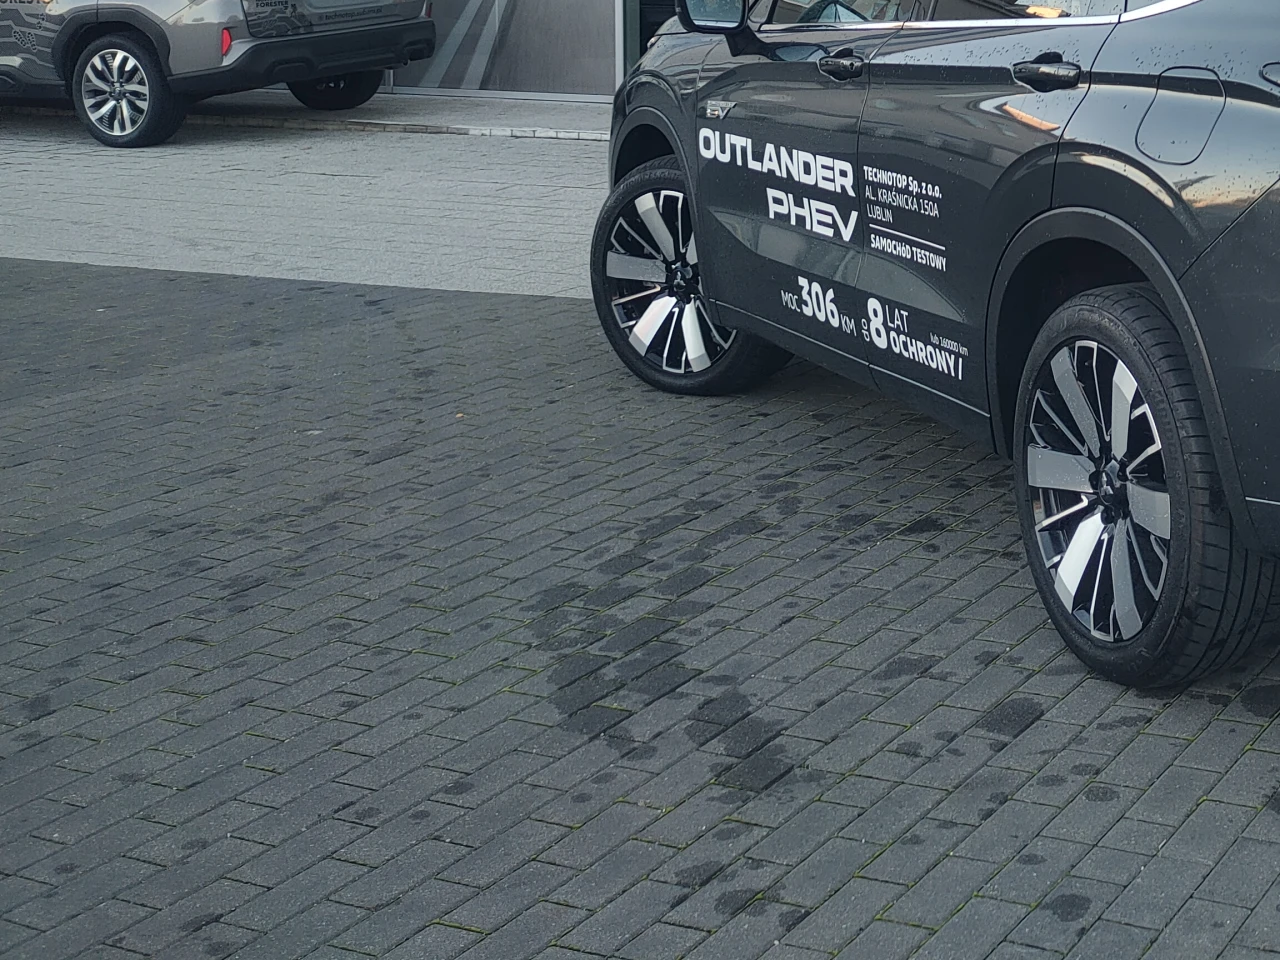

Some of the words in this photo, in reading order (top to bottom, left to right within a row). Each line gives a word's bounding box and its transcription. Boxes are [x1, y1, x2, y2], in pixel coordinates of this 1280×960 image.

[699, 127, 856, 197] OUTLANDER
[863, 165, 907, 189] TECHNOTOP
[908, 176, 921, 196] Sp.
[927, 184, 942, 199] o.o.
[766, 187, 859, 242] PHEV
[865, 184, 877, 200] AL.
[877, 187, 918, 212] KRAŚNICKA
[919, 199, 939, 218] 150A
[866, 203, 893, 223] LUBLIN
[912, 246, 947, 272] TESTOWY
[780, 289, 801, 312] MOC
[798, 275, 840, 328] 306
[840, 313, 857, 337] KM
[867, 297, 888, 349] 8
[886, 304, 909, 333] LAT
